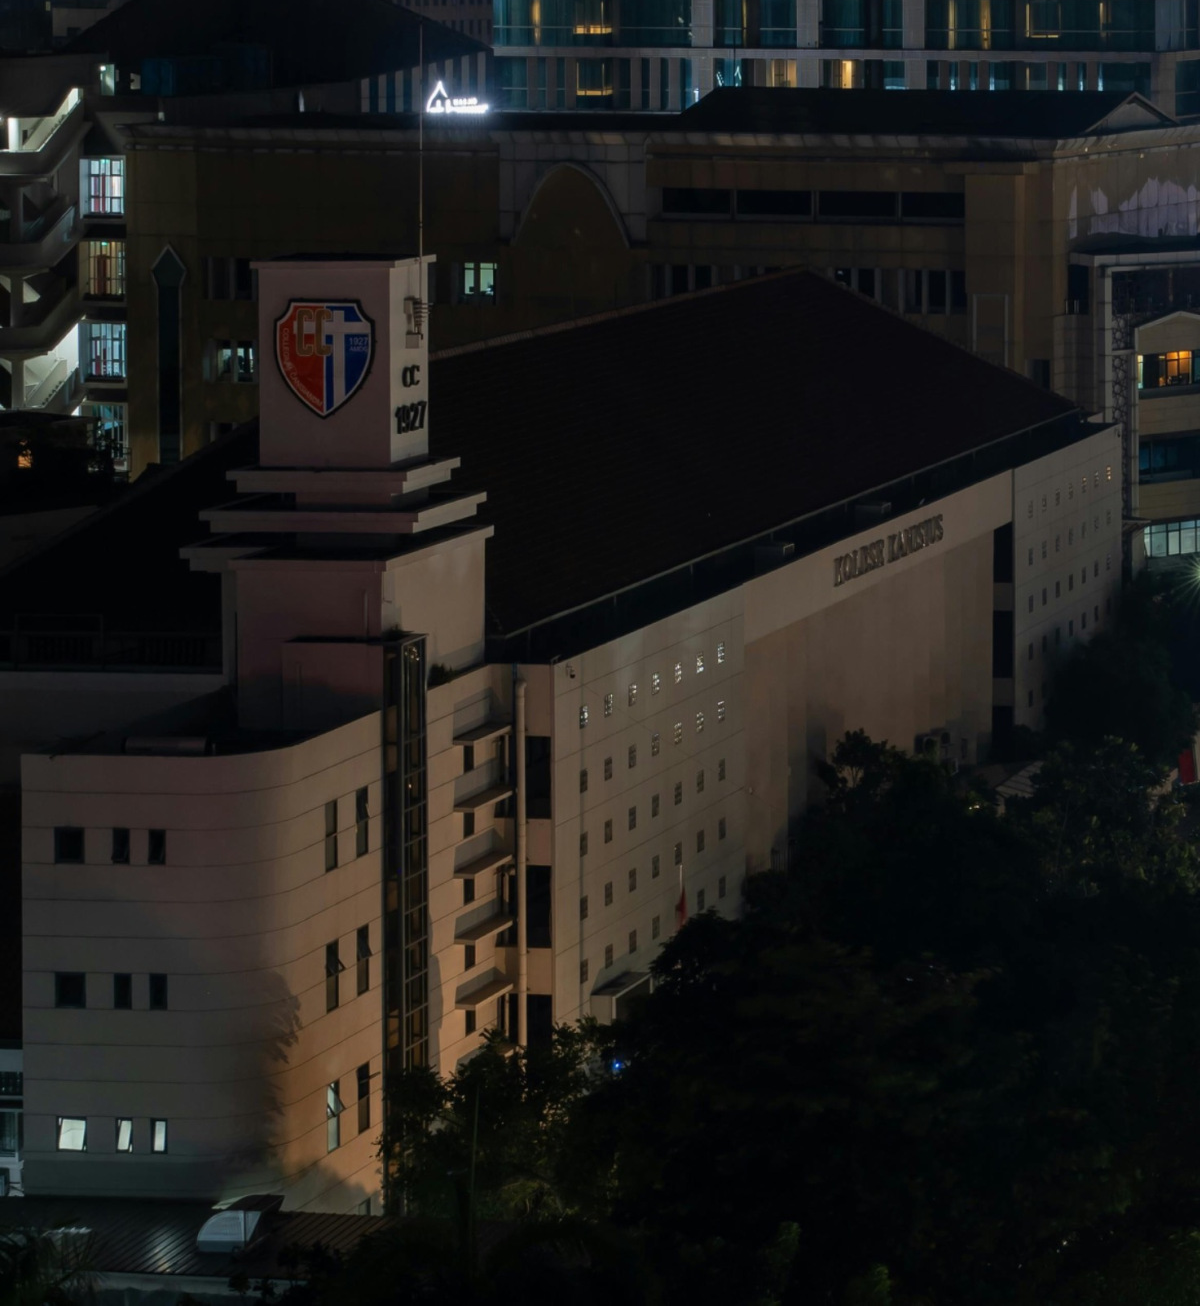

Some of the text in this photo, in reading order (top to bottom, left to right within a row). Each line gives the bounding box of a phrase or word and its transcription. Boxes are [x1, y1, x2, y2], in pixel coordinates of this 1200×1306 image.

[296, 308, 332, 356] CC
[349, 337, 368, 346] 1927
[394, 400, 427, 434] 1927
